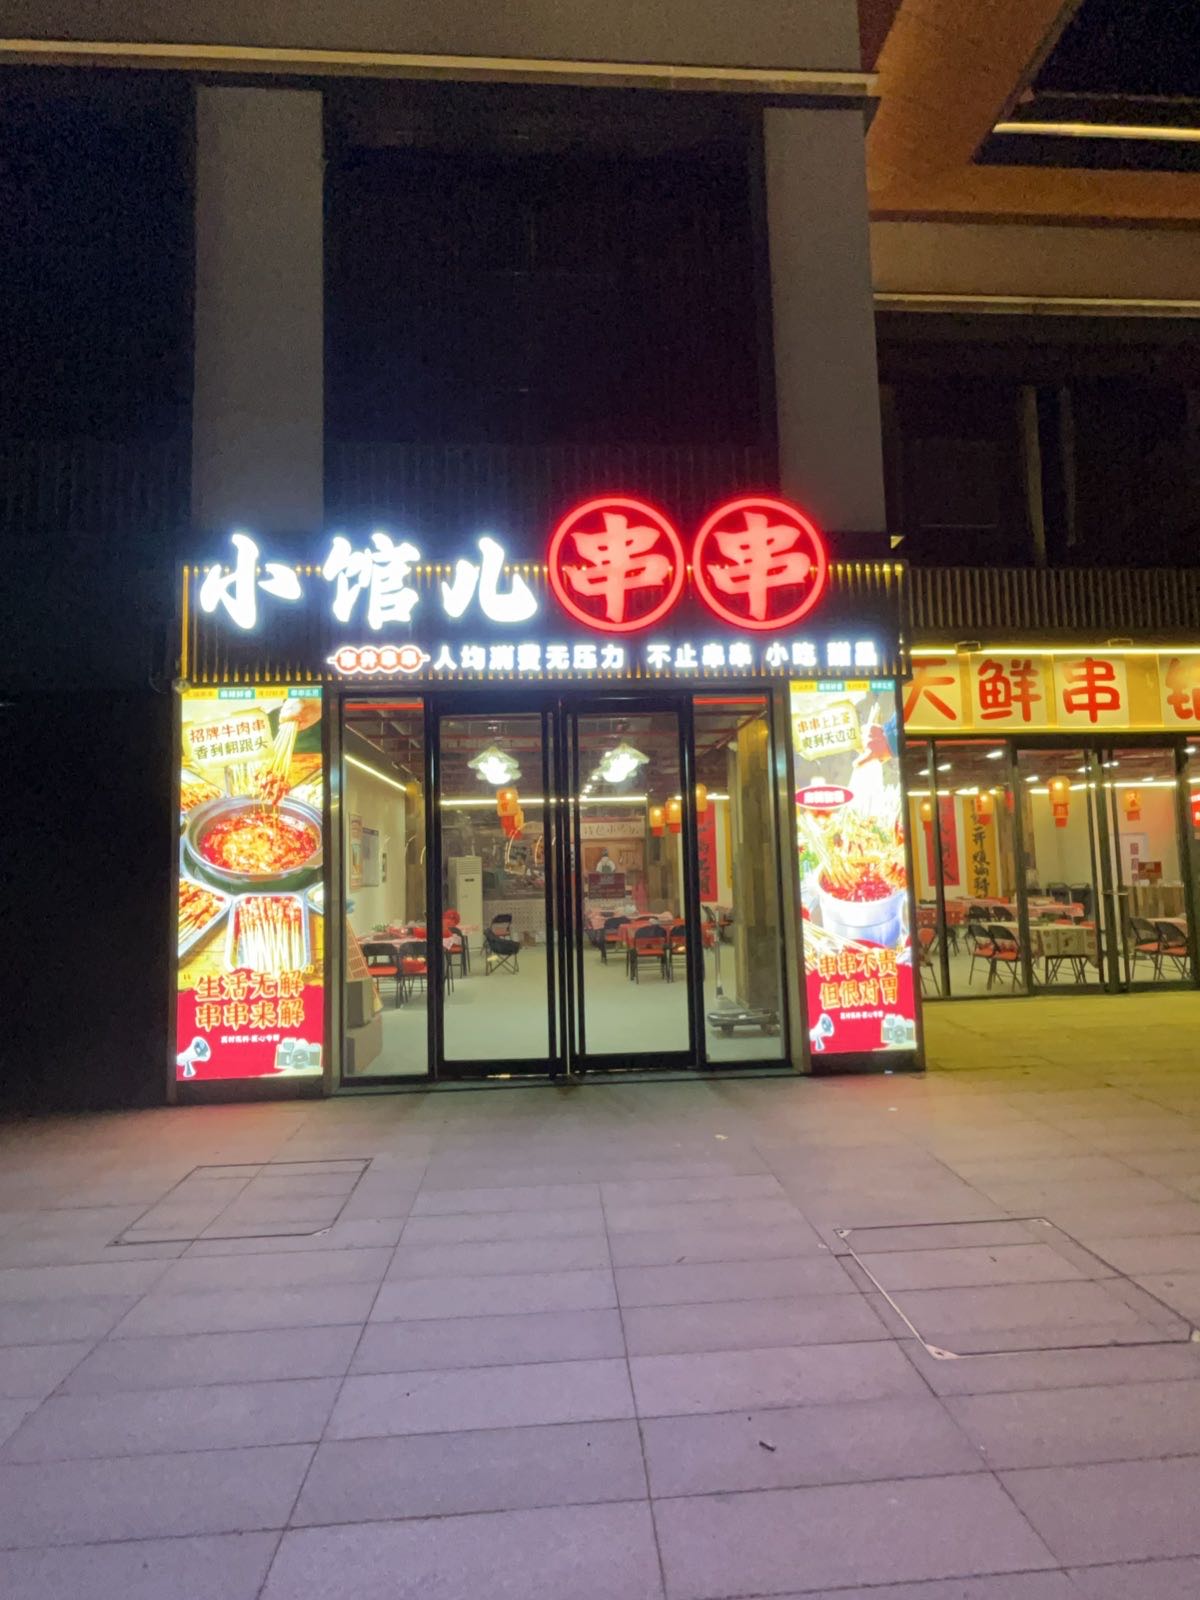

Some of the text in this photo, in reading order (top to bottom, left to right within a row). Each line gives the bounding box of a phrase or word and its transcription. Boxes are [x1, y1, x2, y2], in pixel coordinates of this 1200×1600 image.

[433, 644, 624, 671] 人均消费无压力
[190, 719, 266, 744] 招牌牛肉串
[194, 971, 305, 1002] 生活无解
